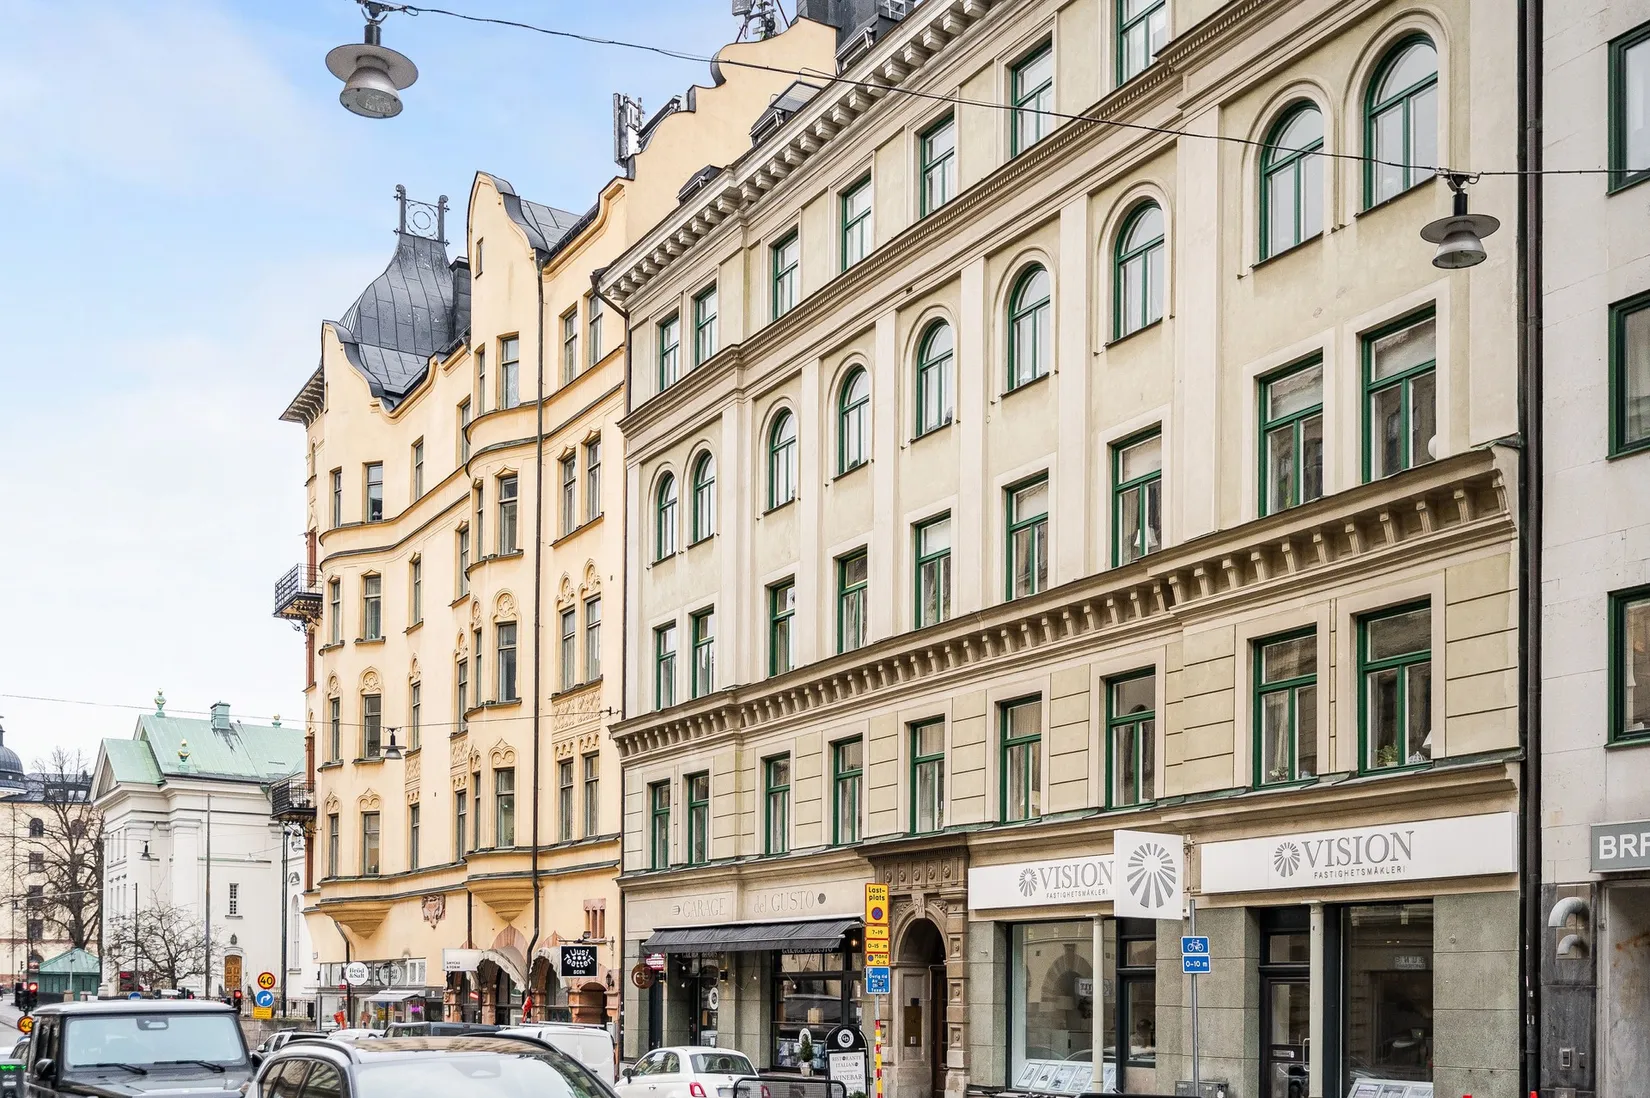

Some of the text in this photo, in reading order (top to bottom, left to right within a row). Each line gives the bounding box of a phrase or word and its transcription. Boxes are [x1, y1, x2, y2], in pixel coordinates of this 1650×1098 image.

[1301, 830, 1415, 869] VISION
[1599, 832, 1650, 860] BRF
[1038, 860, 1114, 890] VISION
[682, 890, 815, 918] GARAGE del GUSTO
[569, 948, 590, 957] Uusi
[1185, 960, 1201, 968] 0-10
[260, 976, 273, 985] 40
